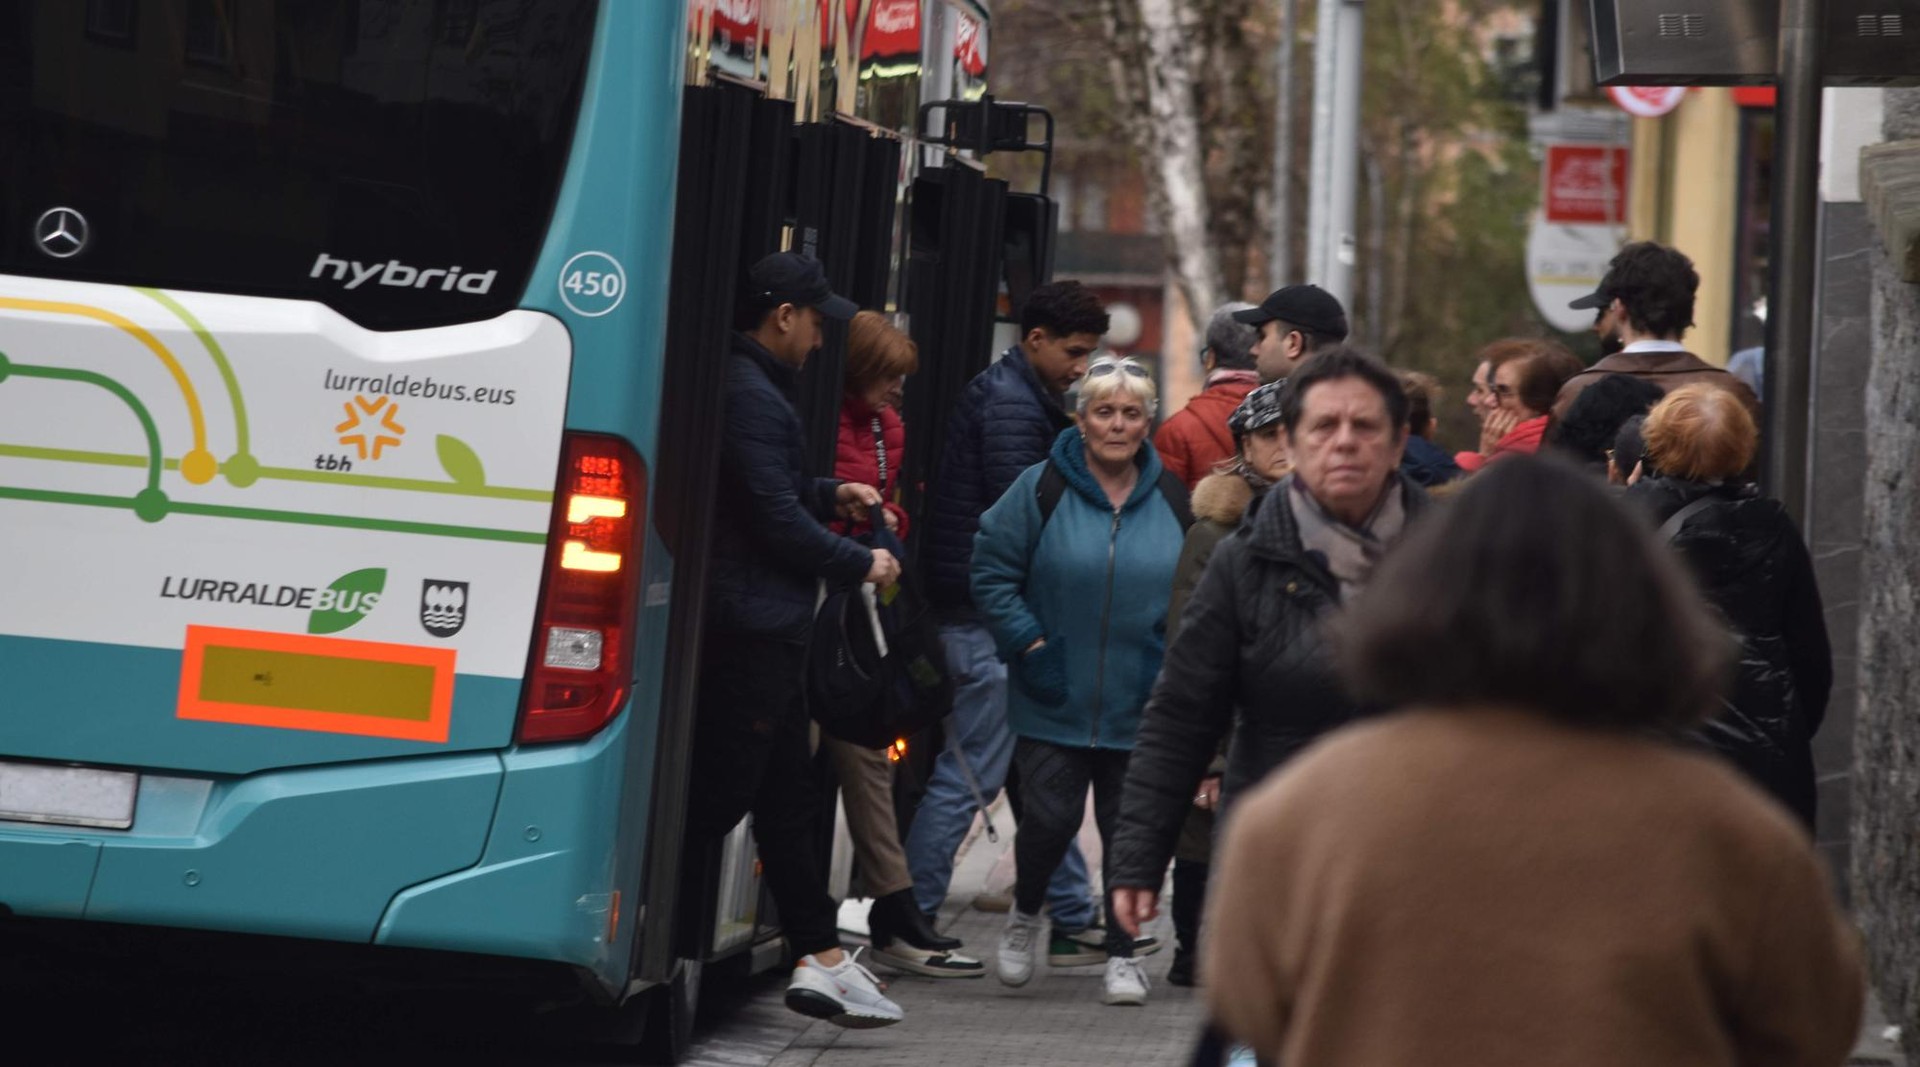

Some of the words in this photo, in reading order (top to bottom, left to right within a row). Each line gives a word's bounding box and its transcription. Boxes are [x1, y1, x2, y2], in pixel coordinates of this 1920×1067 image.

[309, 253, 498, 295] hybrid
[564, 270, 620, 298] 450
[323, 368, 517, 406] lurraldebus.eus
[314, 454, 353, 472] tbh
